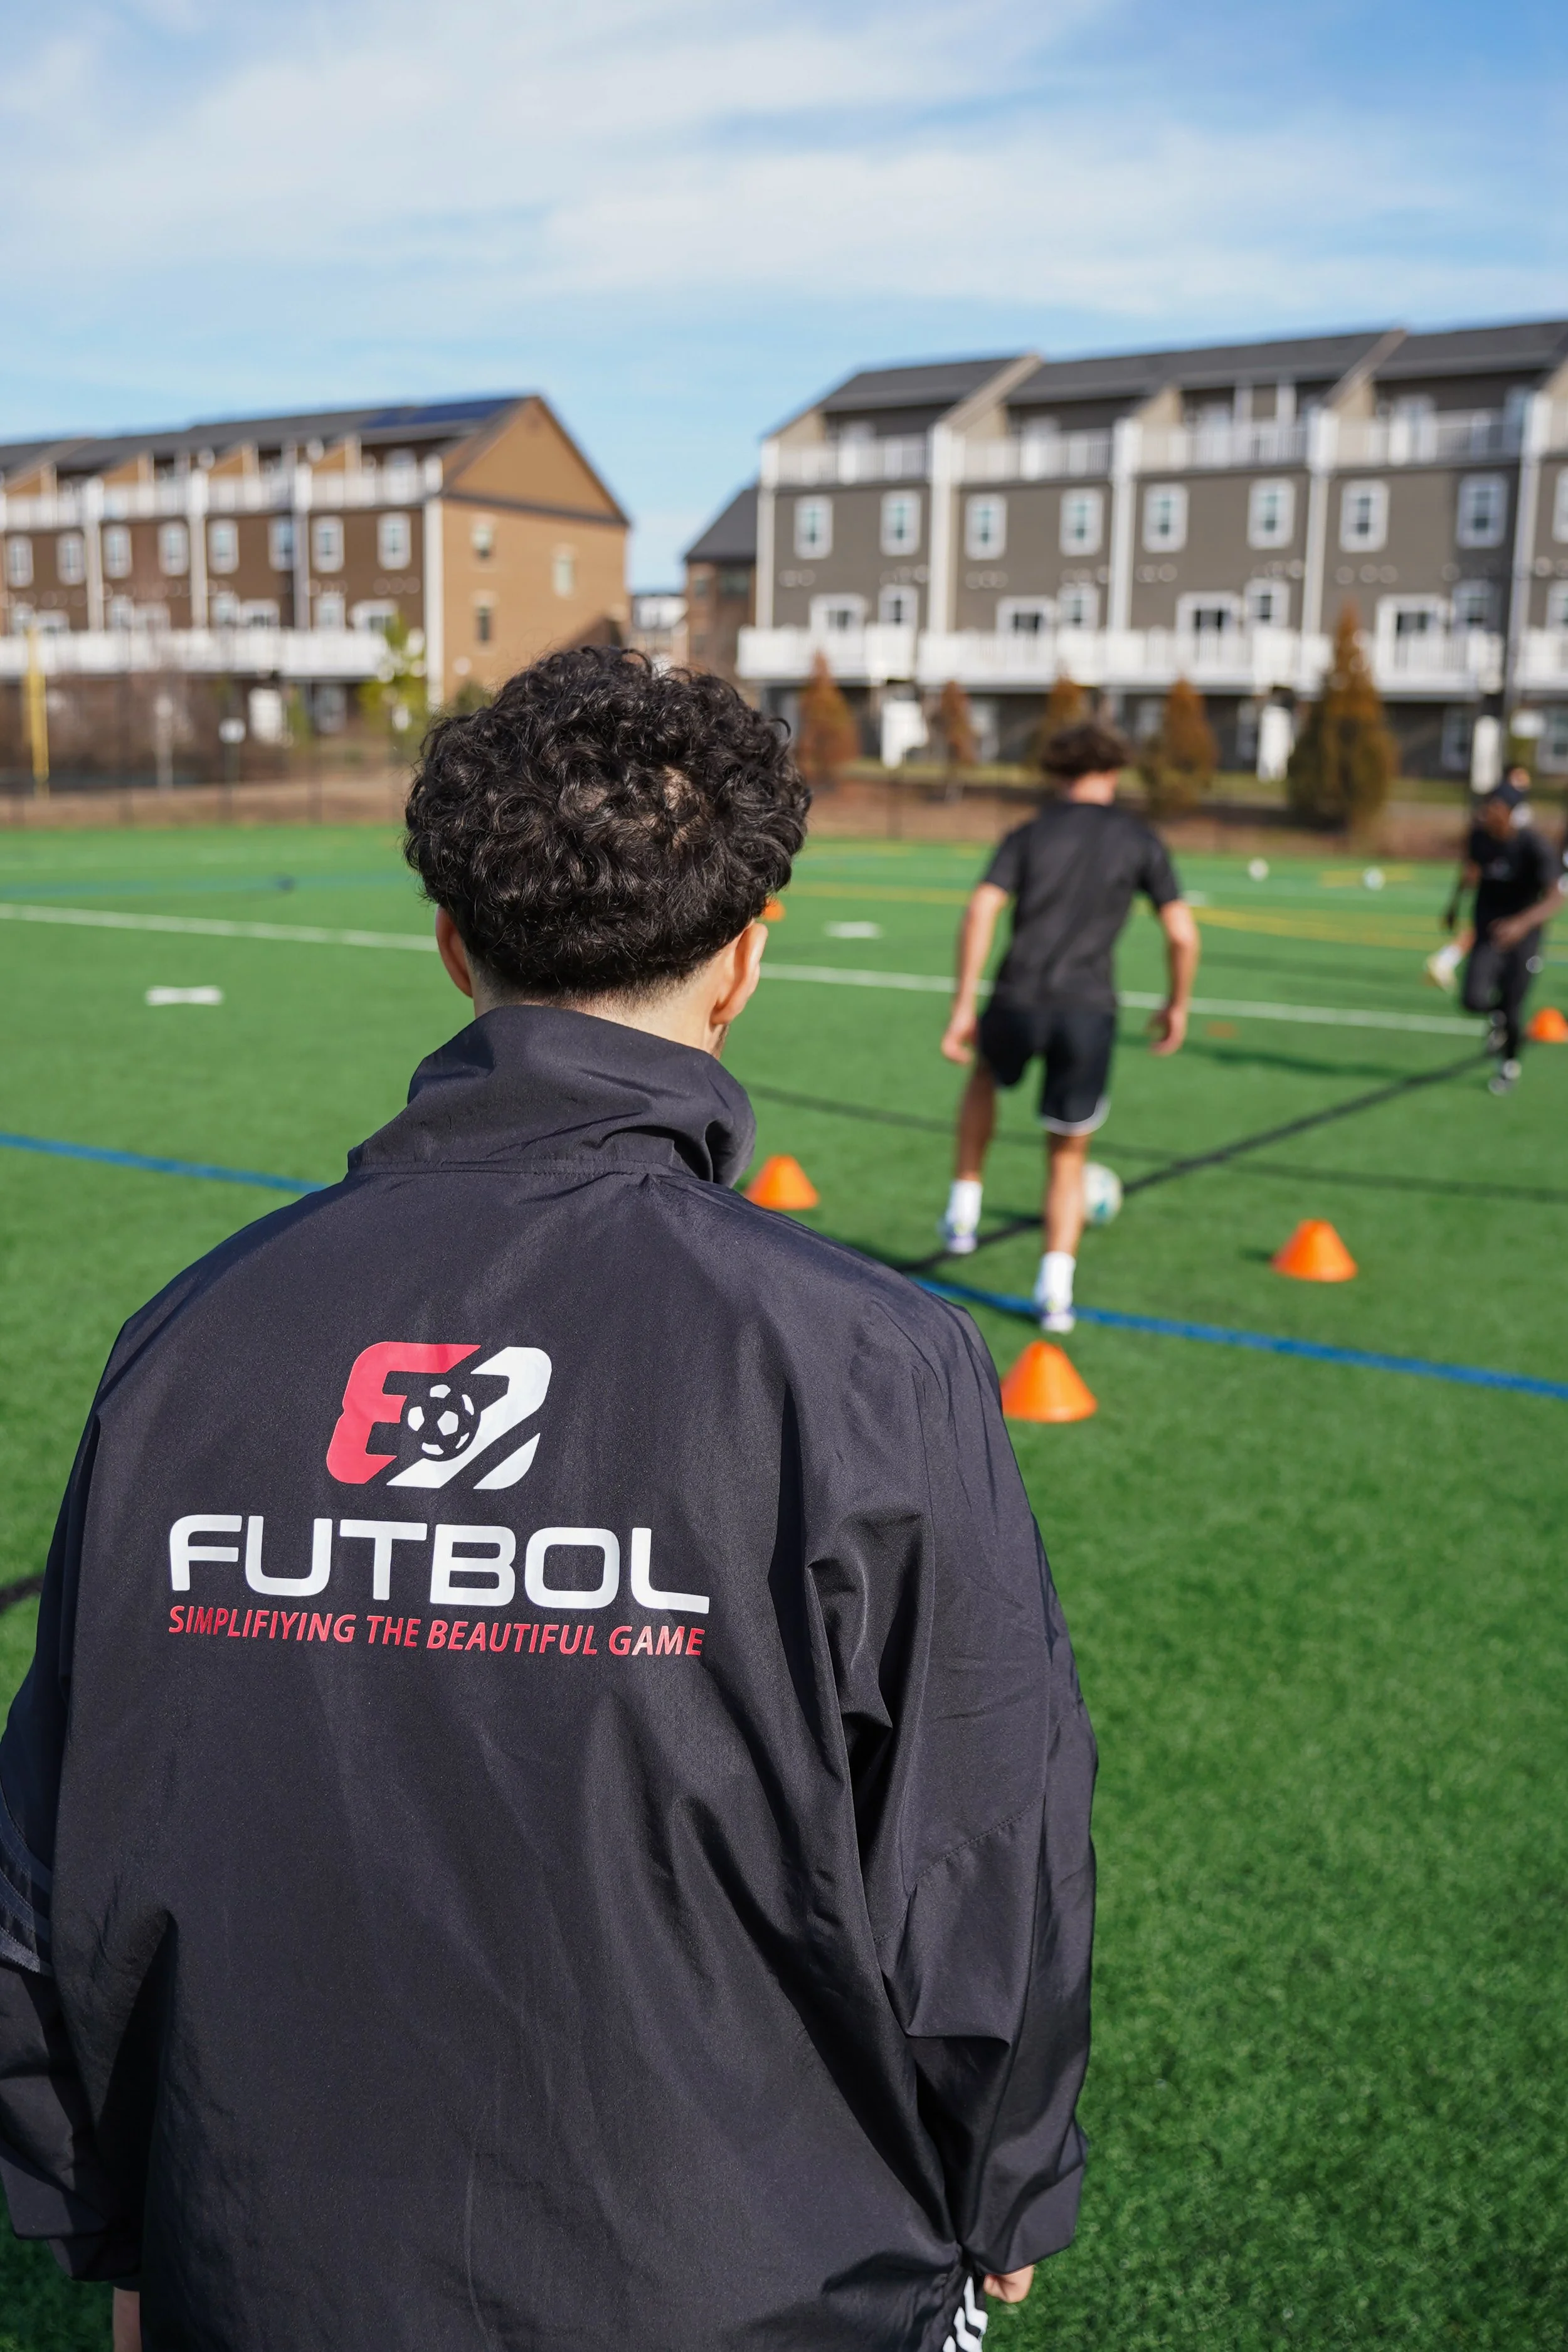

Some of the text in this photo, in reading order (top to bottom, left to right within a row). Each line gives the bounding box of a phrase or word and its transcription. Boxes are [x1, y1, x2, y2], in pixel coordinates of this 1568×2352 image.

[169, 1514, 710, 1614] FUTBOL
[169, 1606, 705, 1656] SIMPLIFIYING THE BEAUTIFUL GAME
